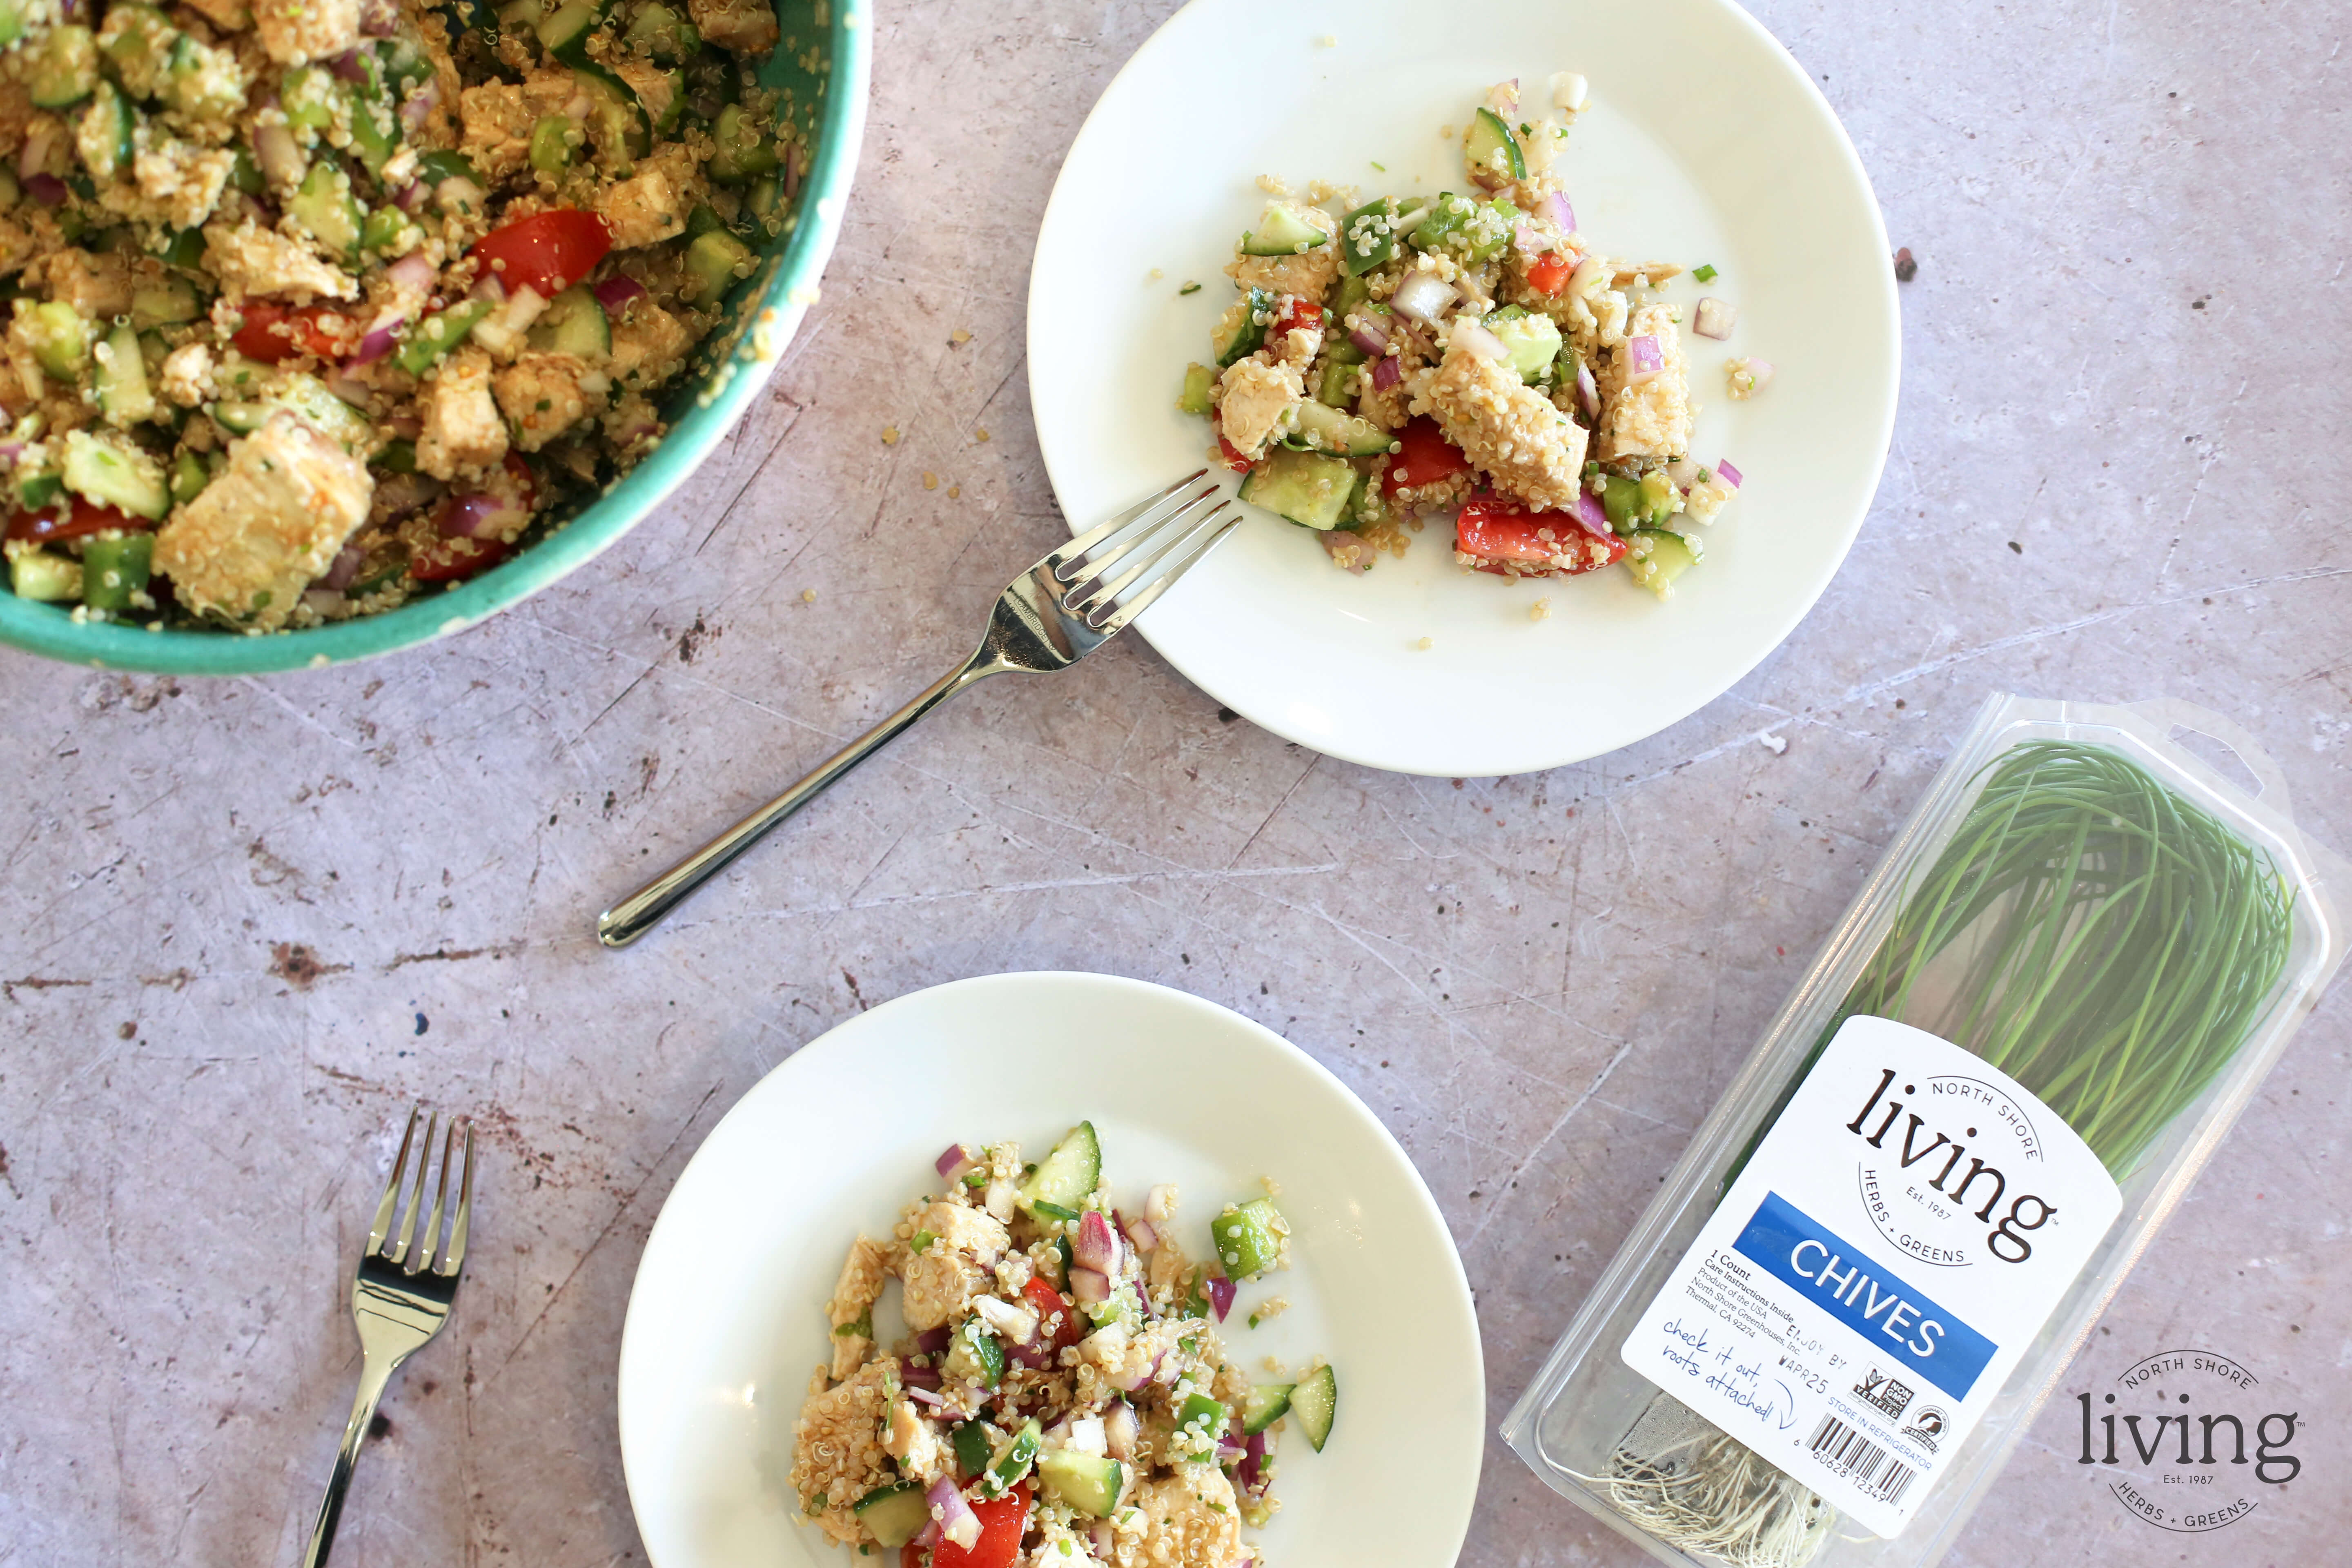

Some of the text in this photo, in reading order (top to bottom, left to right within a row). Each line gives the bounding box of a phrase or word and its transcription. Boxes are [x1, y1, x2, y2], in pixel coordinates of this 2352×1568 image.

[1017, 599, 1049, 640] CAMBRIDGE
[1932, 1082, 2038, 1160] NORTH SHORE
[1846, 1069, 2057, 1263] living
[1865, 1170, 1889, 1222] HERBS
[1900, 1234, 1964, 1262] GREENS
[1906, 1186, 1951, 1221] Est. 1987
[1705, 1258, 1793, 1323] Care Instructions Inside
[1711, 1250, 1751, 1281] 1 Count
[1686, 1285, 1755, 1337] Thermal, CA 92274
[1691, 1276, 1801, 1356] North Shore Greenhouses, Inc.
[1697, 1267, 1727, 1291] Product
[1737, 1295, 1749, 1306] the
[1751, 1303, 1766, 1319] USA
[1791, 1239, 1945, 1357] CHIVES
[1664, 1318, 1762, 1387] check it out,
[1829, 1354, 1847, 1369] BY
[1663, 1345, 1773, 1421] roots attached!
[1849, 1392, 1895, 1425] nongmoproject.org
[1856, 1386, 1899, 1418] VERIFIED
[1882, 1394, 1904, 1411] Project
[1886, 1388, 1907, 1405] GMO
[1890, 1381, 1912, 1399] NON
[1828, 1396, 1858, 1420] STORE
[1857, 1416, 1869, 1428] IN
[1869, 1424, 1932, 1471] REFRIGERATOR
[1906, 1429, 1935, 1450] CERTIFIED
[1813, 1450, 1849, 1478] 60628
[1853, 1476, 1886, 1502] 12349
